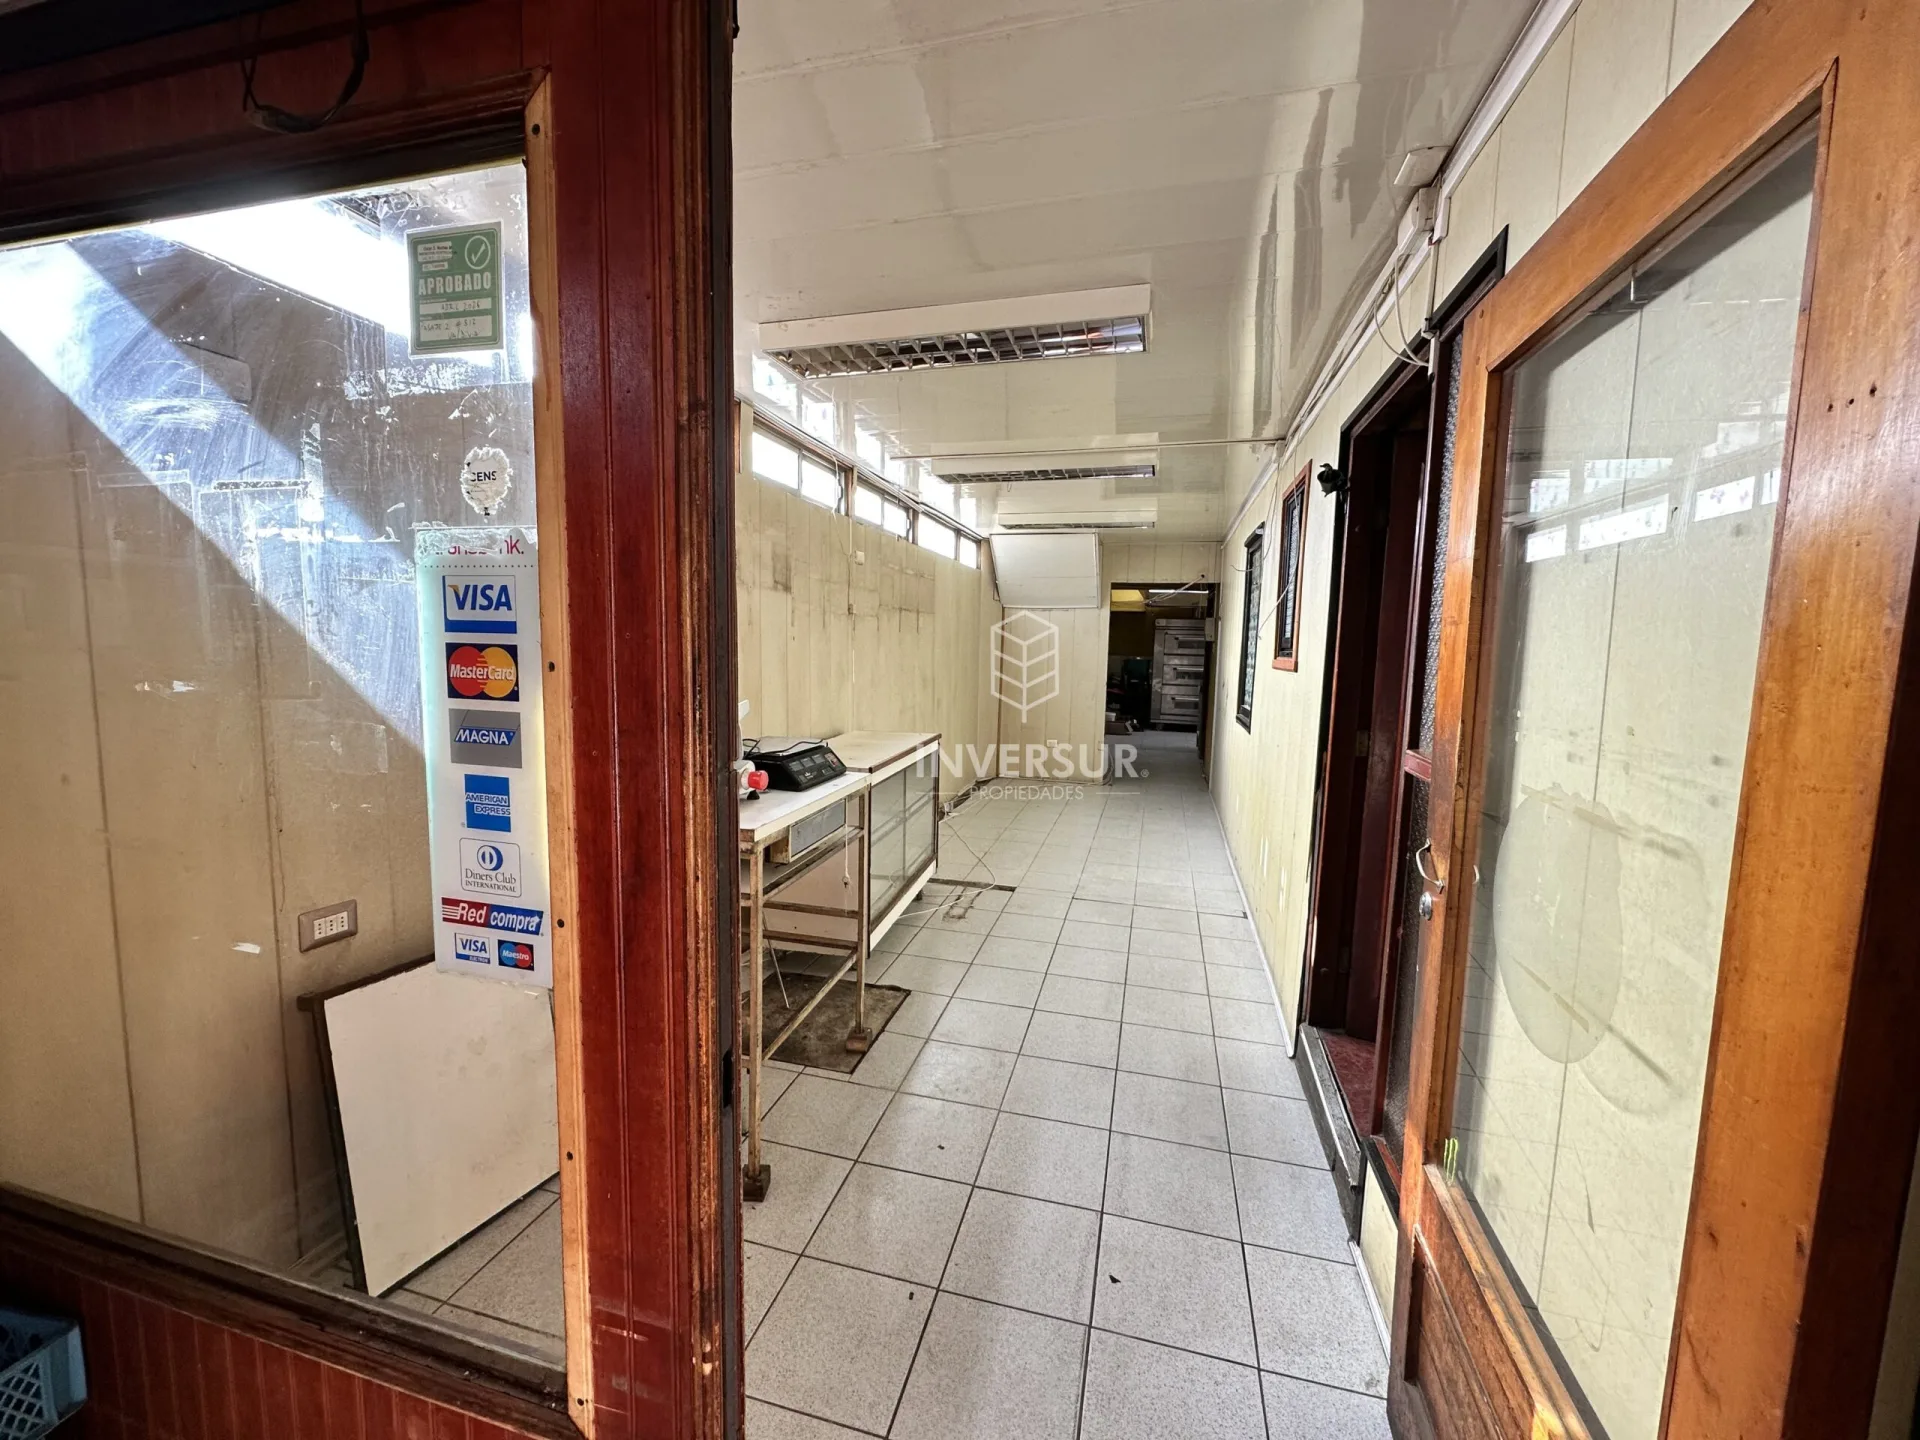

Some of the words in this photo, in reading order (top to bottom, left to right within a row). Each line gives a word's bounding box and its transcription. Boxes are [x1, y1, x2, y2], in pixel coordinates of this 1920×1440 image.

[418, 272, 492, 296] APROBADO
[448, 584, 513, 612] VISA
[450, 663, 516, 682] MasterCard
[455, 728, 509, 746] MAGNA
[466, 793, 507, 804] AMERICAN
[475, 805, 511, 816] EXPRESS
[465, 868, 493, 882] Diners
[495, 872, 517, 884] Club
[465, 880, 517, 893] INTERNATIONAL
[458, 902, 487, 924] Red
[490, 910, 540, 932] compra
[459, 938, 487, 954] VISA
[502, 950, 530, 961] Maestro
